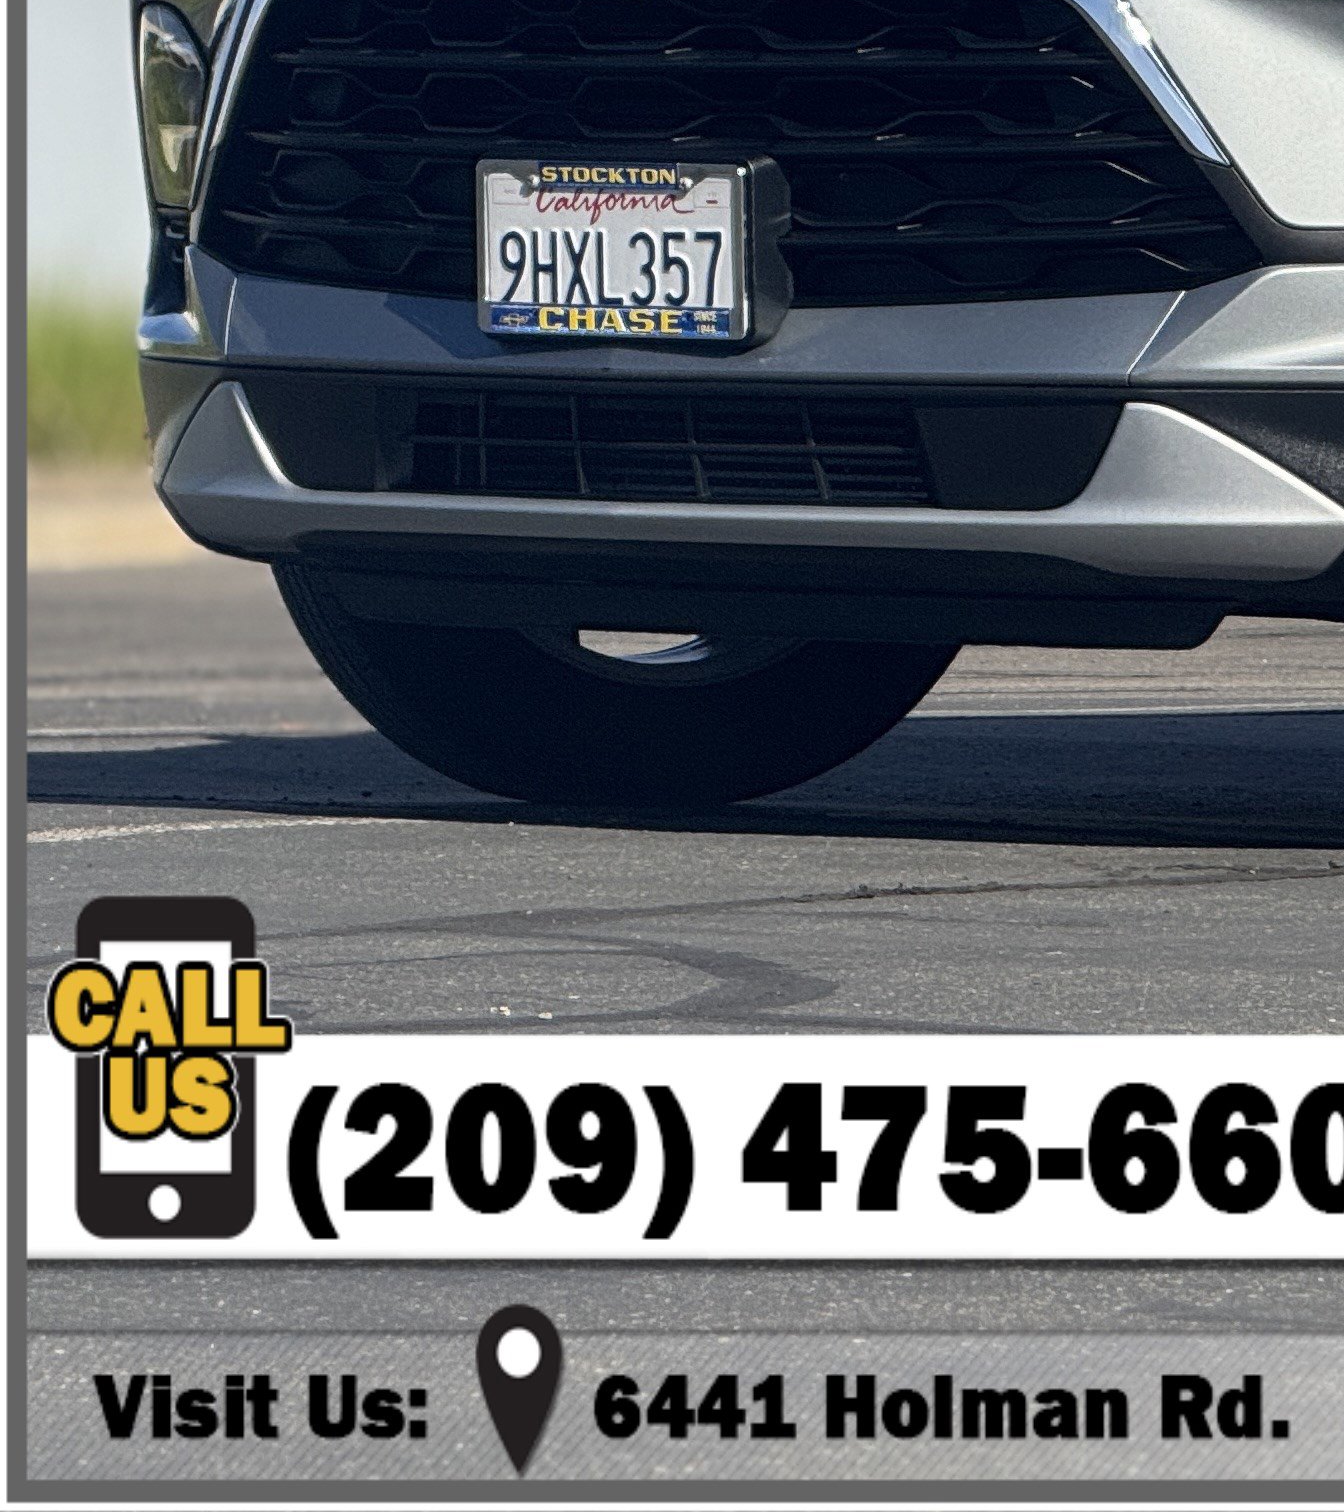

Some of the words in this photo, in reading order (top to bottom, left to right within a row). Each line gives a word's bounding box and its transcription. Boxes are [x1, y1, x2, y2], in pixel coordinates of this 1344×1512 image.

[541, 166, 677, 185] STOCKTON
[535, 188, 695, 225] California
[500, 230, 722, 307] 9HXL357
[538, 307, 683, 334] CHASE
